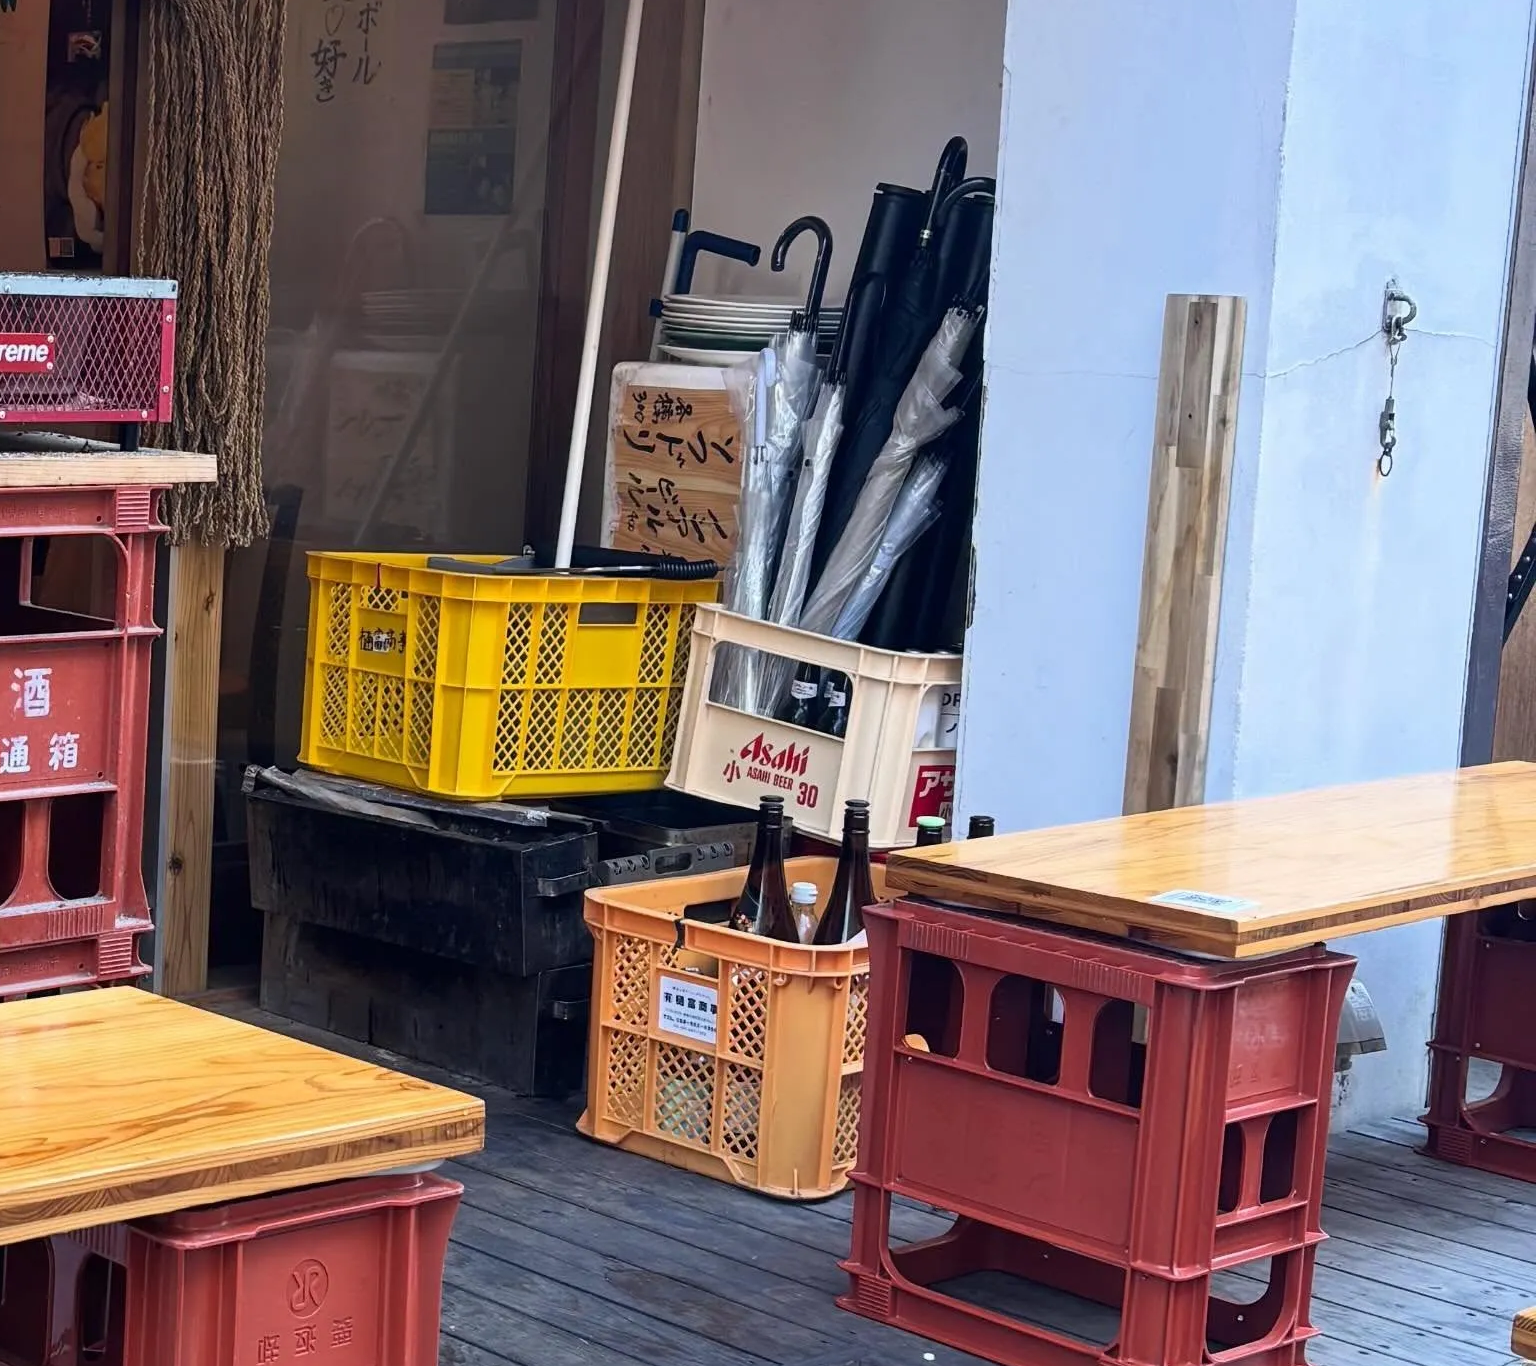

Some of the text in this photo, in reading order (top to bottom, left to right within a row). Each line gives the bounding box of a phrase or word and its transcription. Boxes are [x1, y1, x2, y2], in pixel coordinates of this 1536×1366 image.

[740, 732, 810, 776] Asahi
[722, 760, 742, 783] 小
[747, 766, 794, 791] ASAHI BEER
[796, 781, 819, 808] 30
[256, 1317, 354, 1366] 要返却
